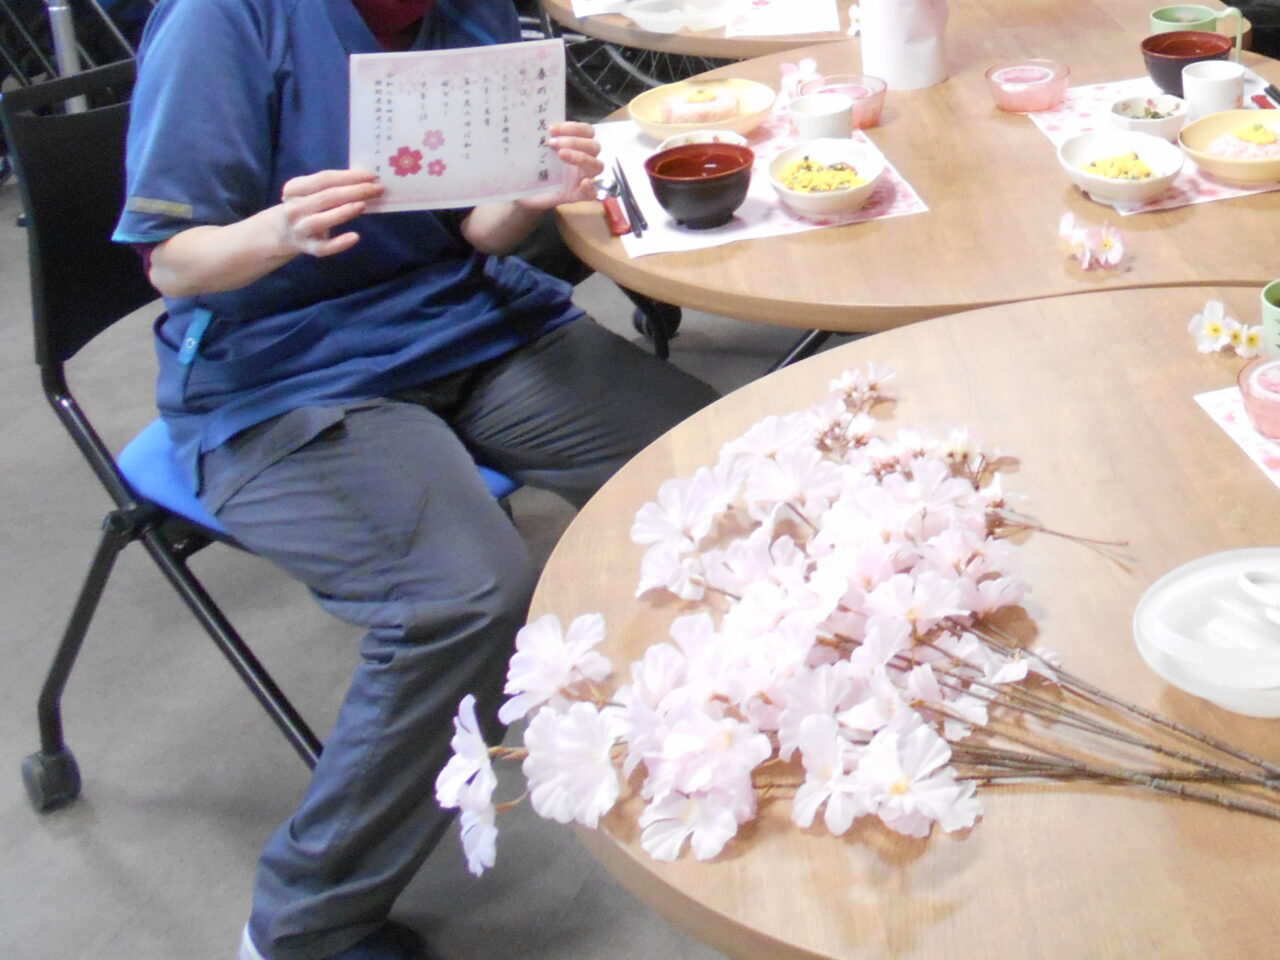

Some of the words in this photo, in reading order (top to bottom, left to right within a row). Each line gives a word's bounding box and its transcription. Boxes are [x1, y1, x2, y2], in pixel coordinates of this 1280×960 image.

[537, 67, 549, 182] 春のお花見ご膳
